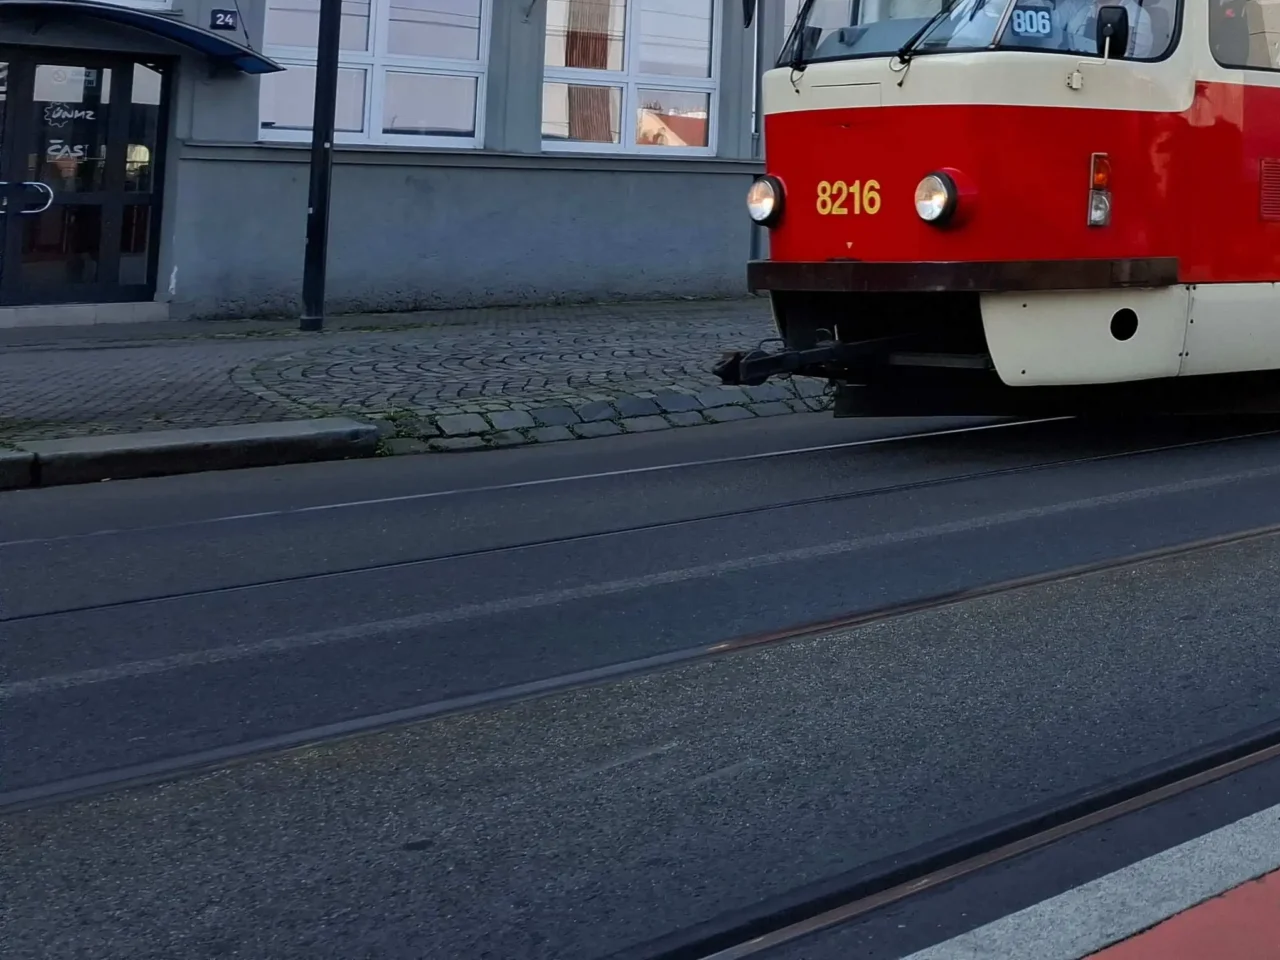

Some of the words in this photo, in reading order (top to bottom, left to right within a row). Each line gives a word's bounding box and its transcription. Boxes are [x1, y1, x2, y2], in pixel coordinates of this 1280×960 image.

[215, 13, 234, 26] 24
[1012, 9, 1051, 34] 806
[816, 179, 882, 215] 8216
